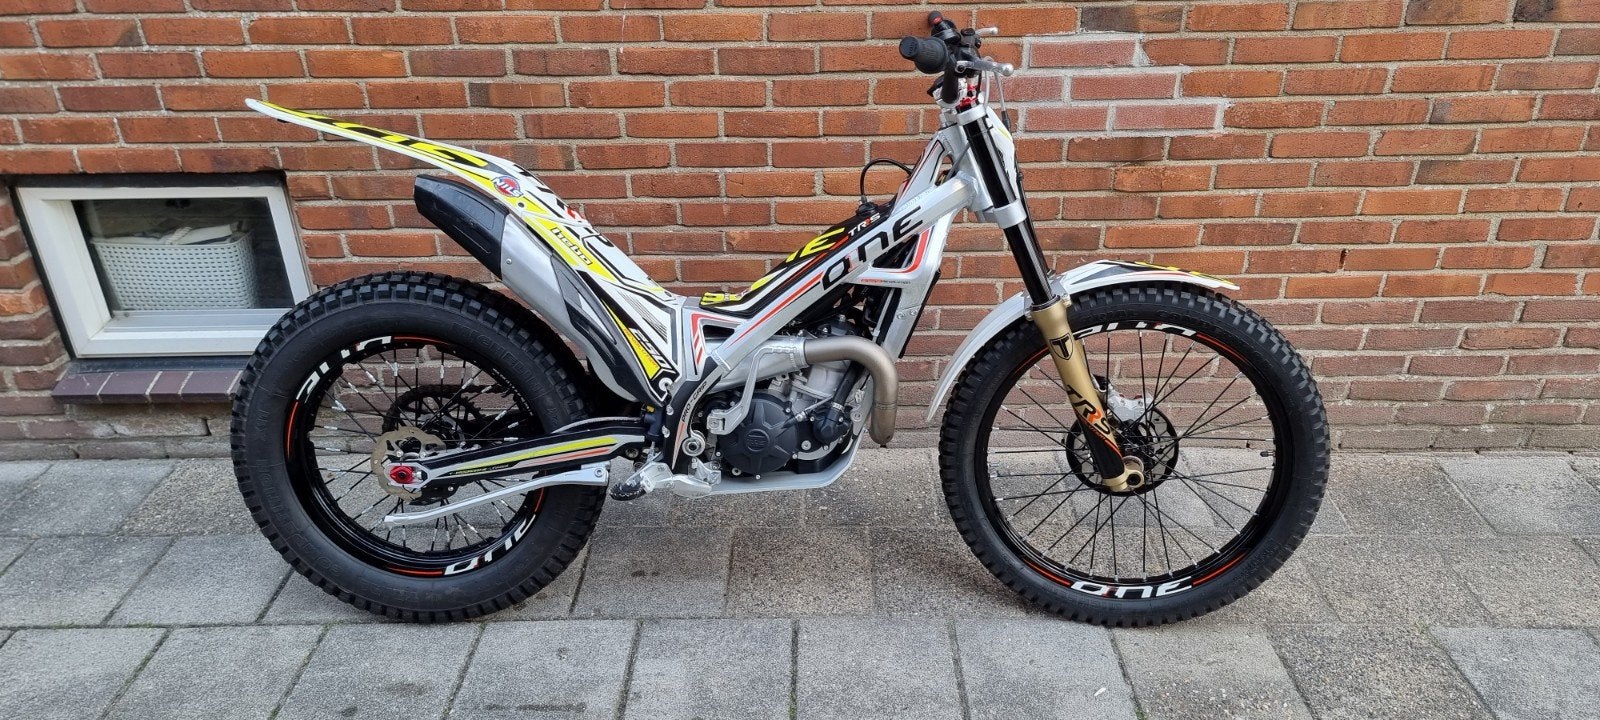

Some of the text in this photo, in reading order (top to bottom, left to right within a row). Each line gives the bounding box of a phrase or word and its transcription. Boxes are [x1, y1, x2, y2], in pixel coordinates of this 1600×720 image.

[491, 177, 524, 197] NILS
[550, 226, 593, 265] hebo
[628, 327, 673, 370] 250
